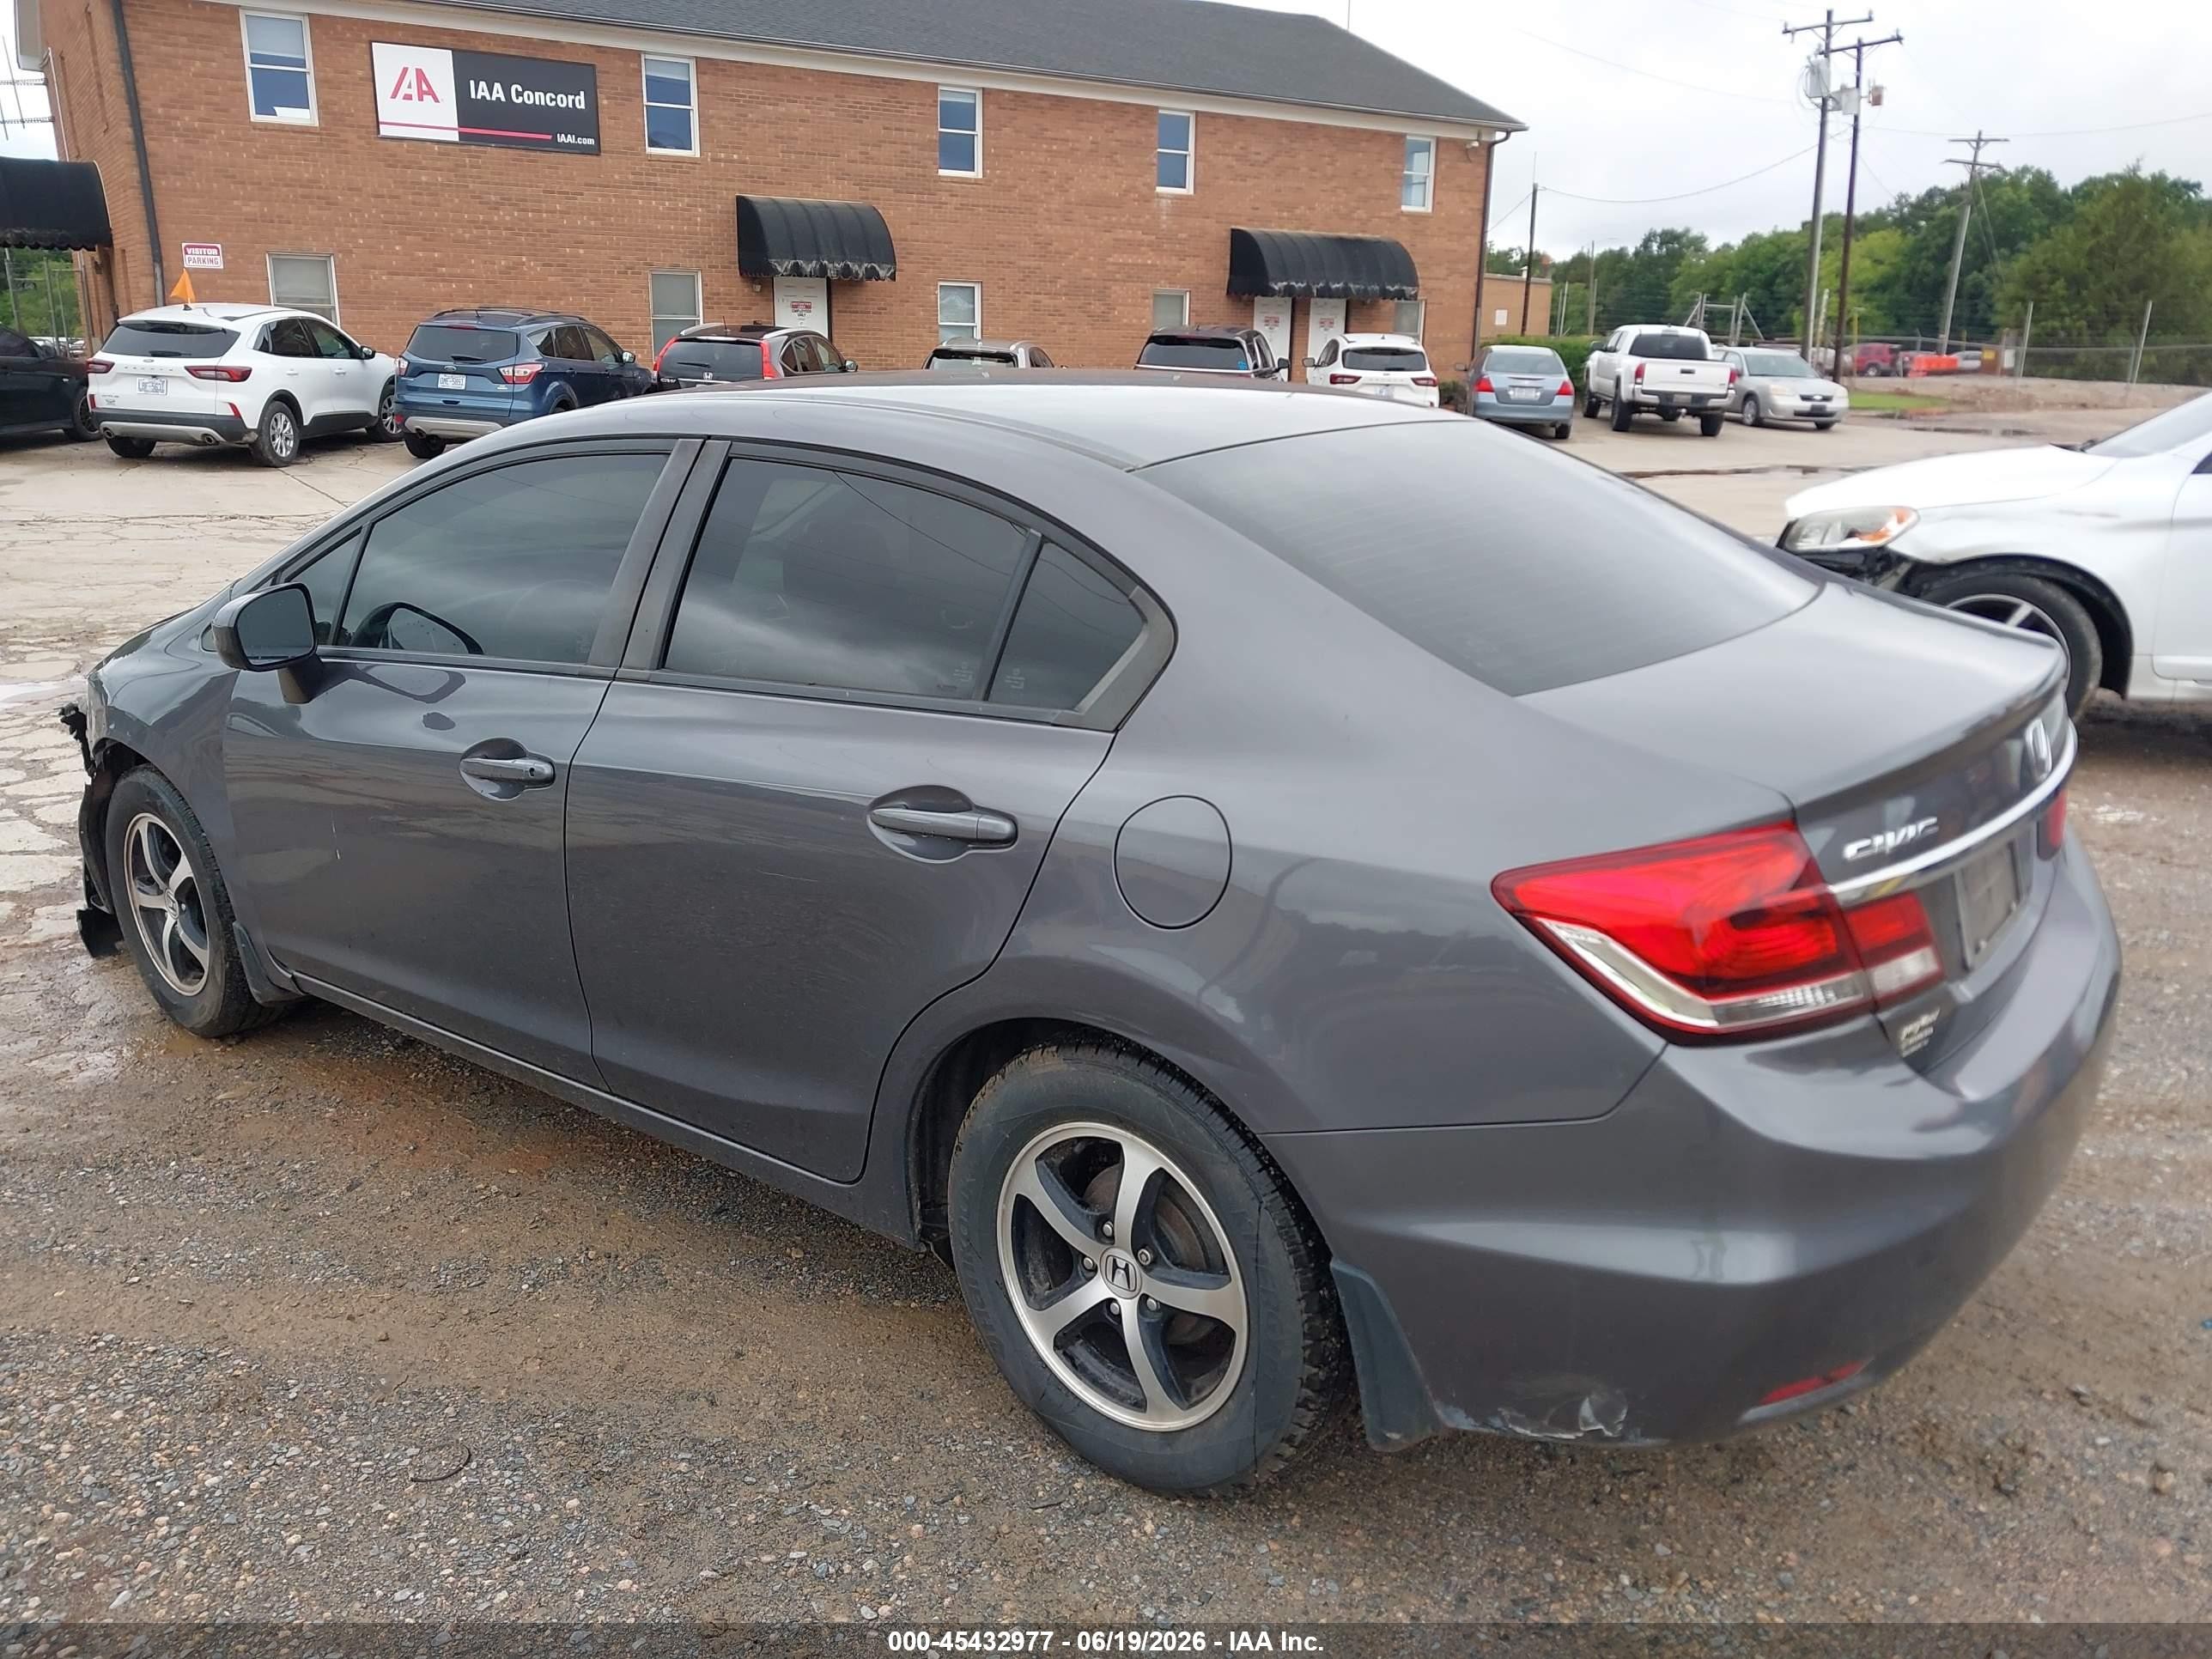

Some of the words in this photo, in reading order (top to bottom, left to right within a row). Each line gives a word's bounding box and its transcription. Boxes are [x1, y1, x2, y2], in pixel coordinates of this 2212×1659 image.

[469, 79, 507, 102] IAA
[510, 83, 586, 110] Concord
[185, 246, 218, 255] VISITOR
[187, 256, 219, 265] PARKING
[1843, 817, 1939, 860] CIVIC
